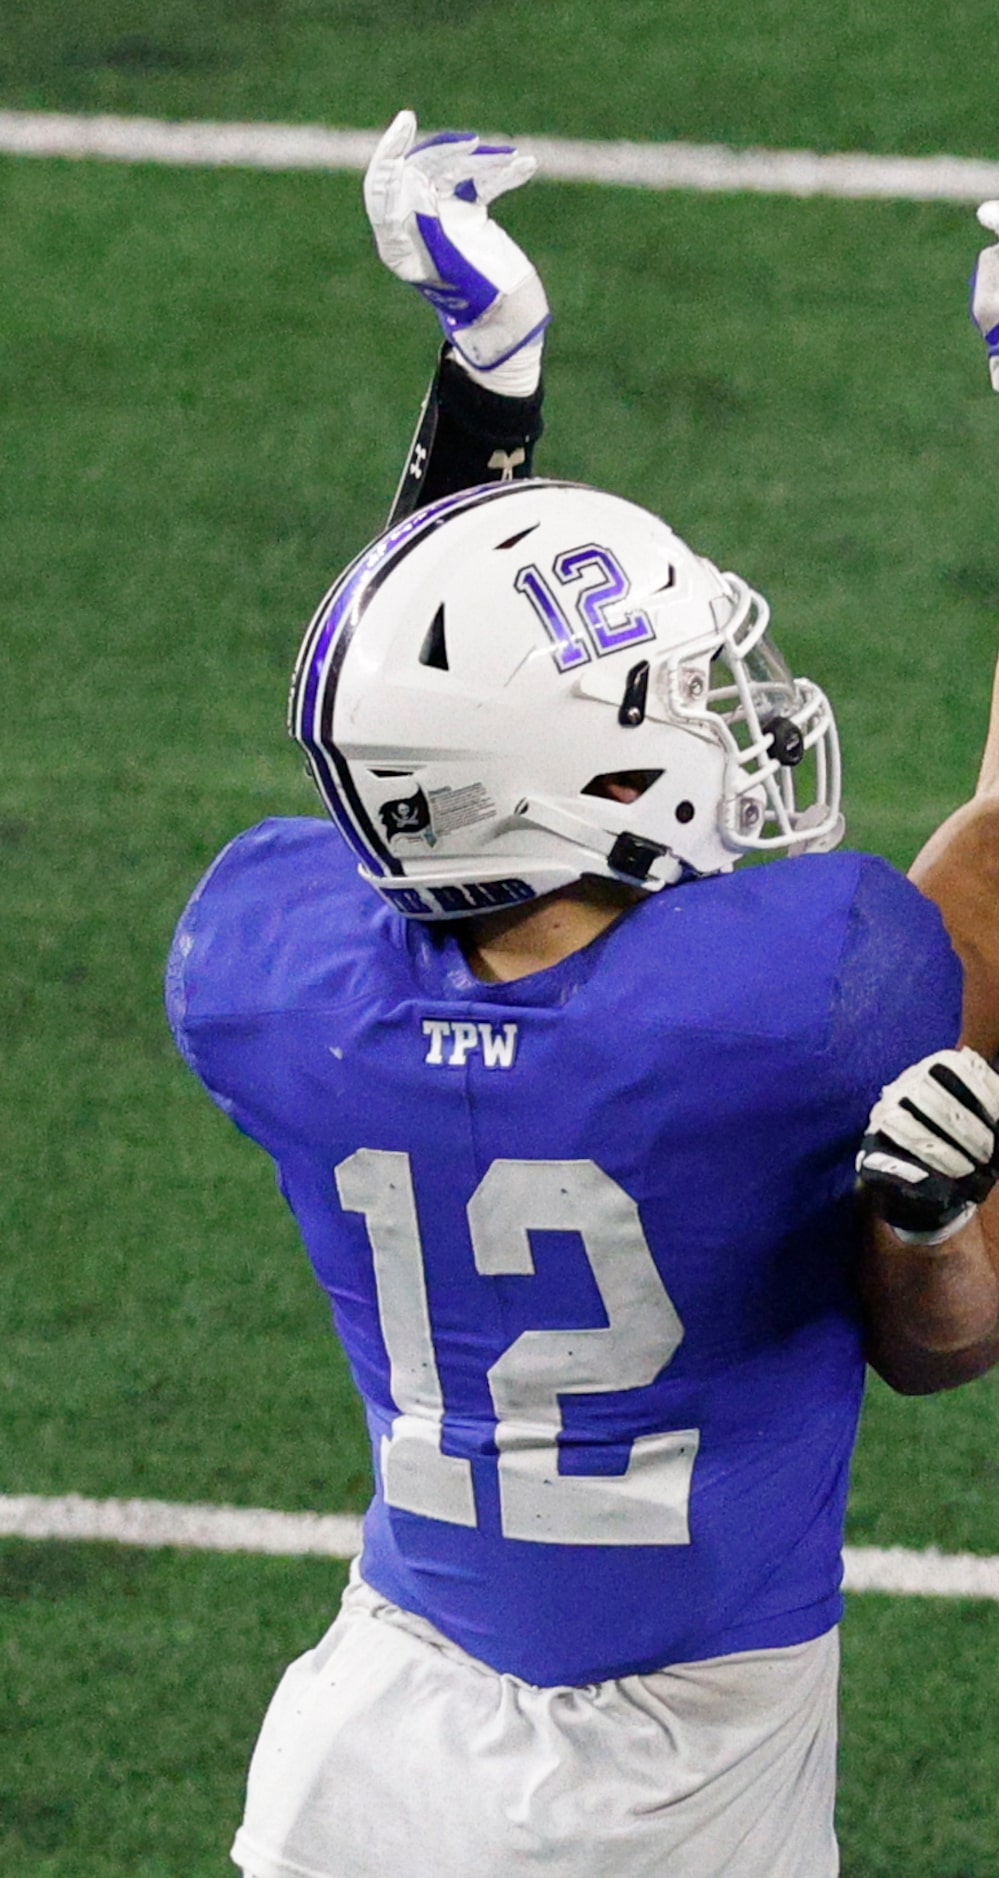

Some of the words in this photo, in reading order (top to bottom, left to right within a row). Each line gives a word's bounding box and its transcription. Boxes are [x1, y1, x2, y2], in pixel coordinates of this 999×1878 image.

[513, 542, 657, 675] 12
[422, 1019, 518, 1068] TPW
[334, 1147, 700, 1544] 12
